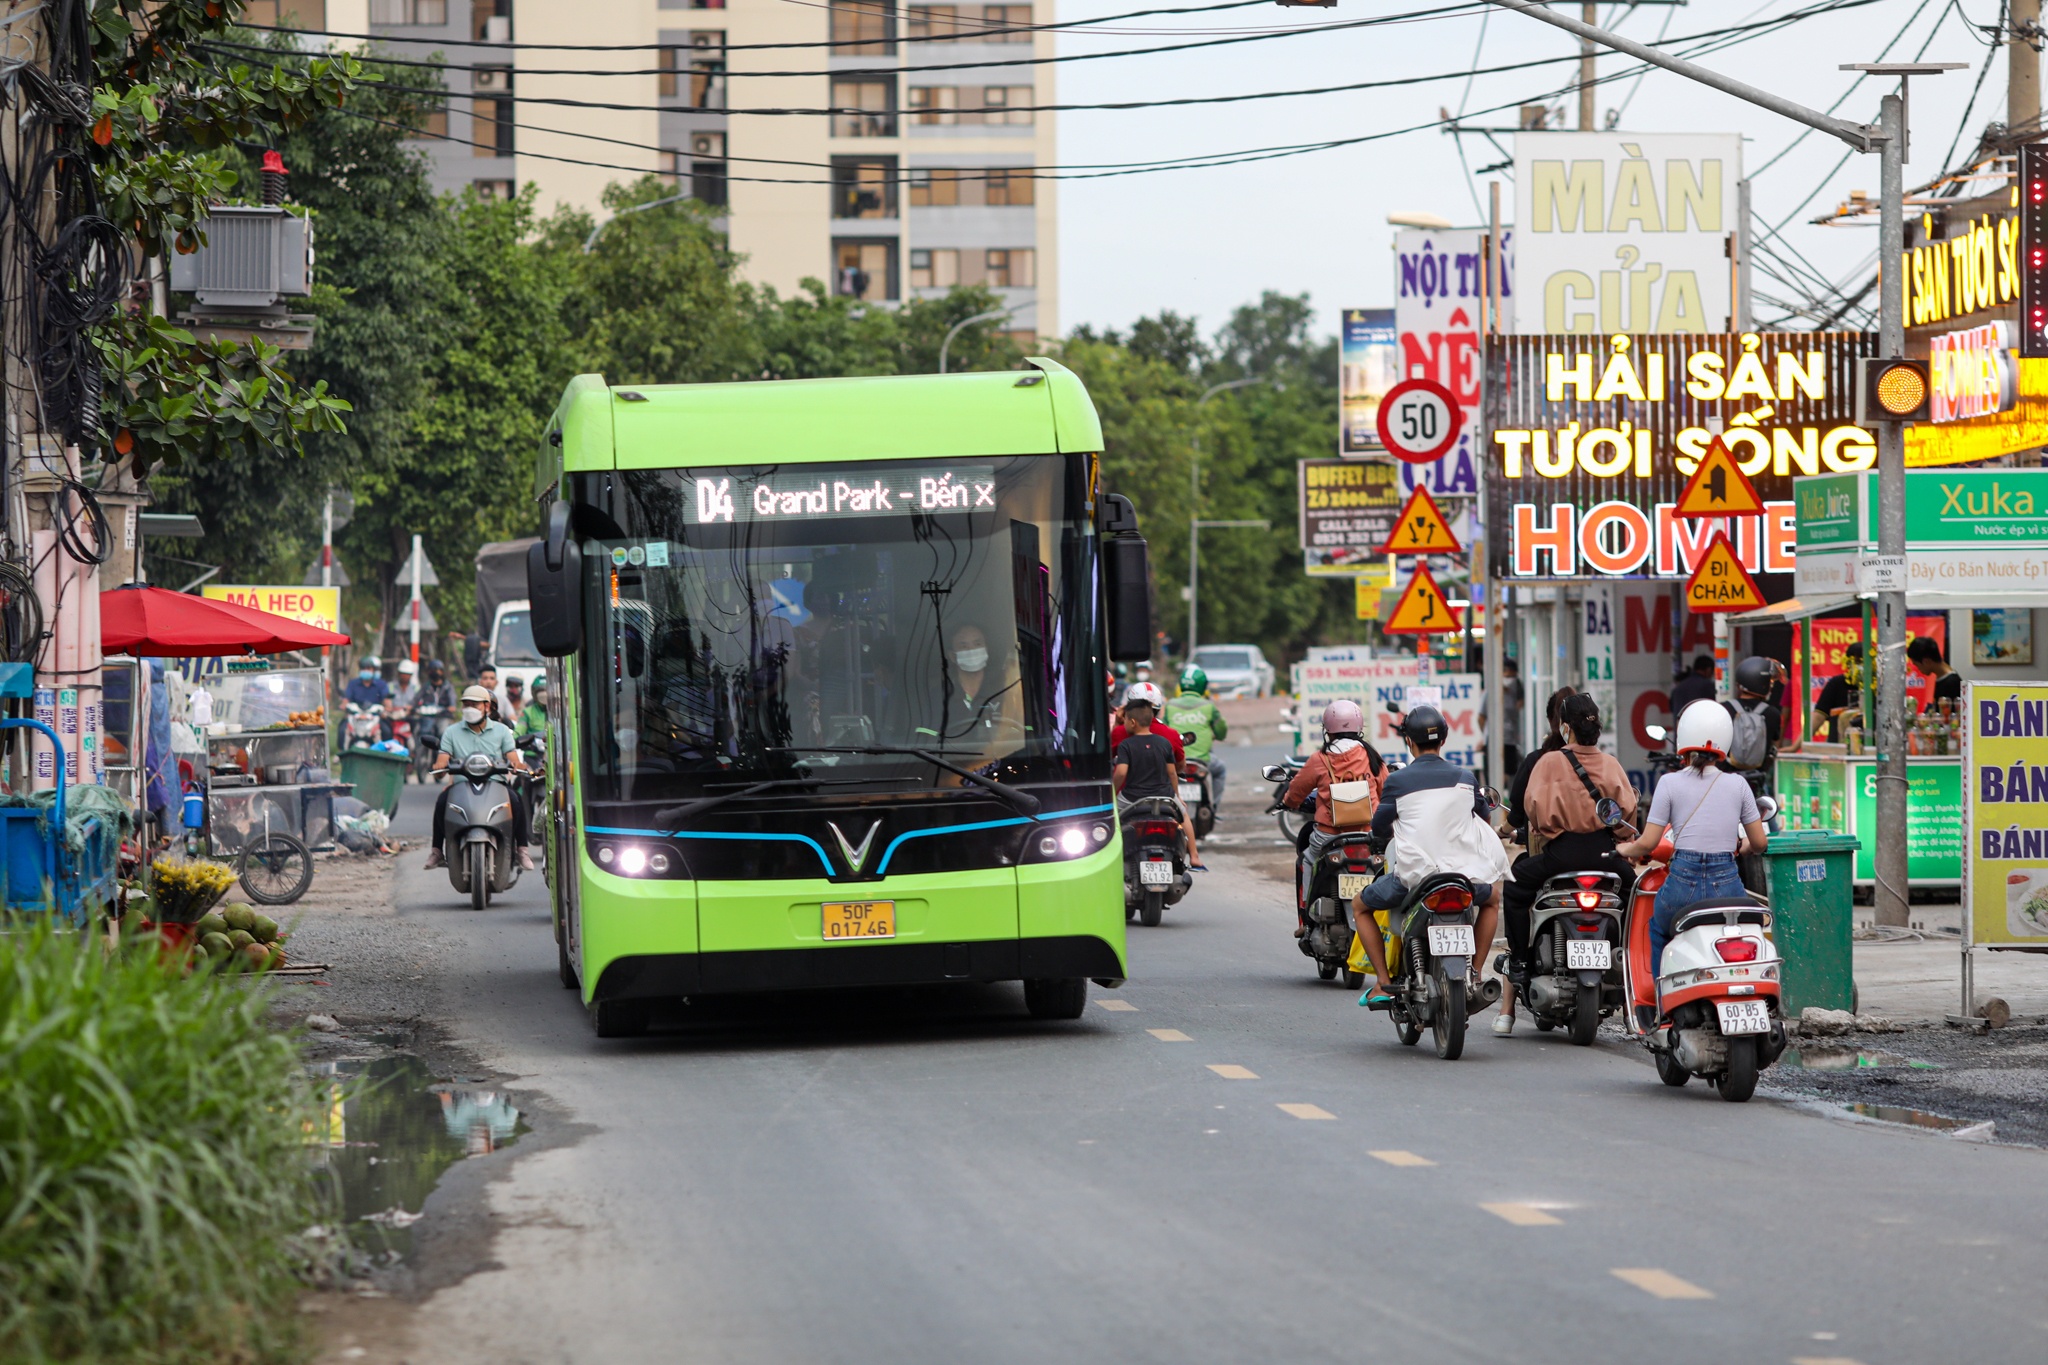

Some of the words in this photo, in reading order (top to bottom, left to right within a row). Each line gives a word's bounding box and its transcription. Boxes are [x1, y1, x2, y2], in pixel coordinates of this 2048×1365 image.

[1531, 142, 1723, 233] MÀN
[1399, 239, 1448, 309] NỘI
[1913, 212, 1950, 326] SẢN
[1951, 212, 1997, 316] TƯƠI
[1543, 243, 1709, 335] CỬA
[1546, 333, 1664, 402] HẢI
[1686, 332, 1825, 401] SẢN
[1401, 402, 1437, 440] 50
[1494, 421, 1653, 478] TƯƠI
[1674, 404, 1878, 478] SỐNG
[1306, 466, 1364, 488] BUFFET
[697, 478, 734, 523] D4
[753, 482, 828, 516] Grand
[833, 480, 893, 512] Park
[919, 471, 968, 509] Bến
[1825, 487, 1851, 519] Juice
[1939, 482, 2035, 516] Xuka
[1710, 561, 1728, 577] ĐI
[1862, 559, 1881, 567] CHO
[1693, 580, 1745, 604] CHẬM
[268, 594, 315, 613] HEO
[1819, 627, 1859, 645] Nhà
[1172, 711, 1208, 725] Grab
[1979, 694, 2048, 738] BÁN
[1981, 824, 2048, 859] BÁN
[843, 904, 874, 920] 50F
[831, 920, 887, 938] 017.46
[1435, 928, 1467, 941] 54-T2
[1437, 940, 1469, 953] 3773
[1573, 942, 1604, 955] 59-V2
[1570, 955, 1608, 967] 603.23
[1725, 1003, 1760, 1018] 60-B5
[1723, 1017, 1767, 1034] 773.26
